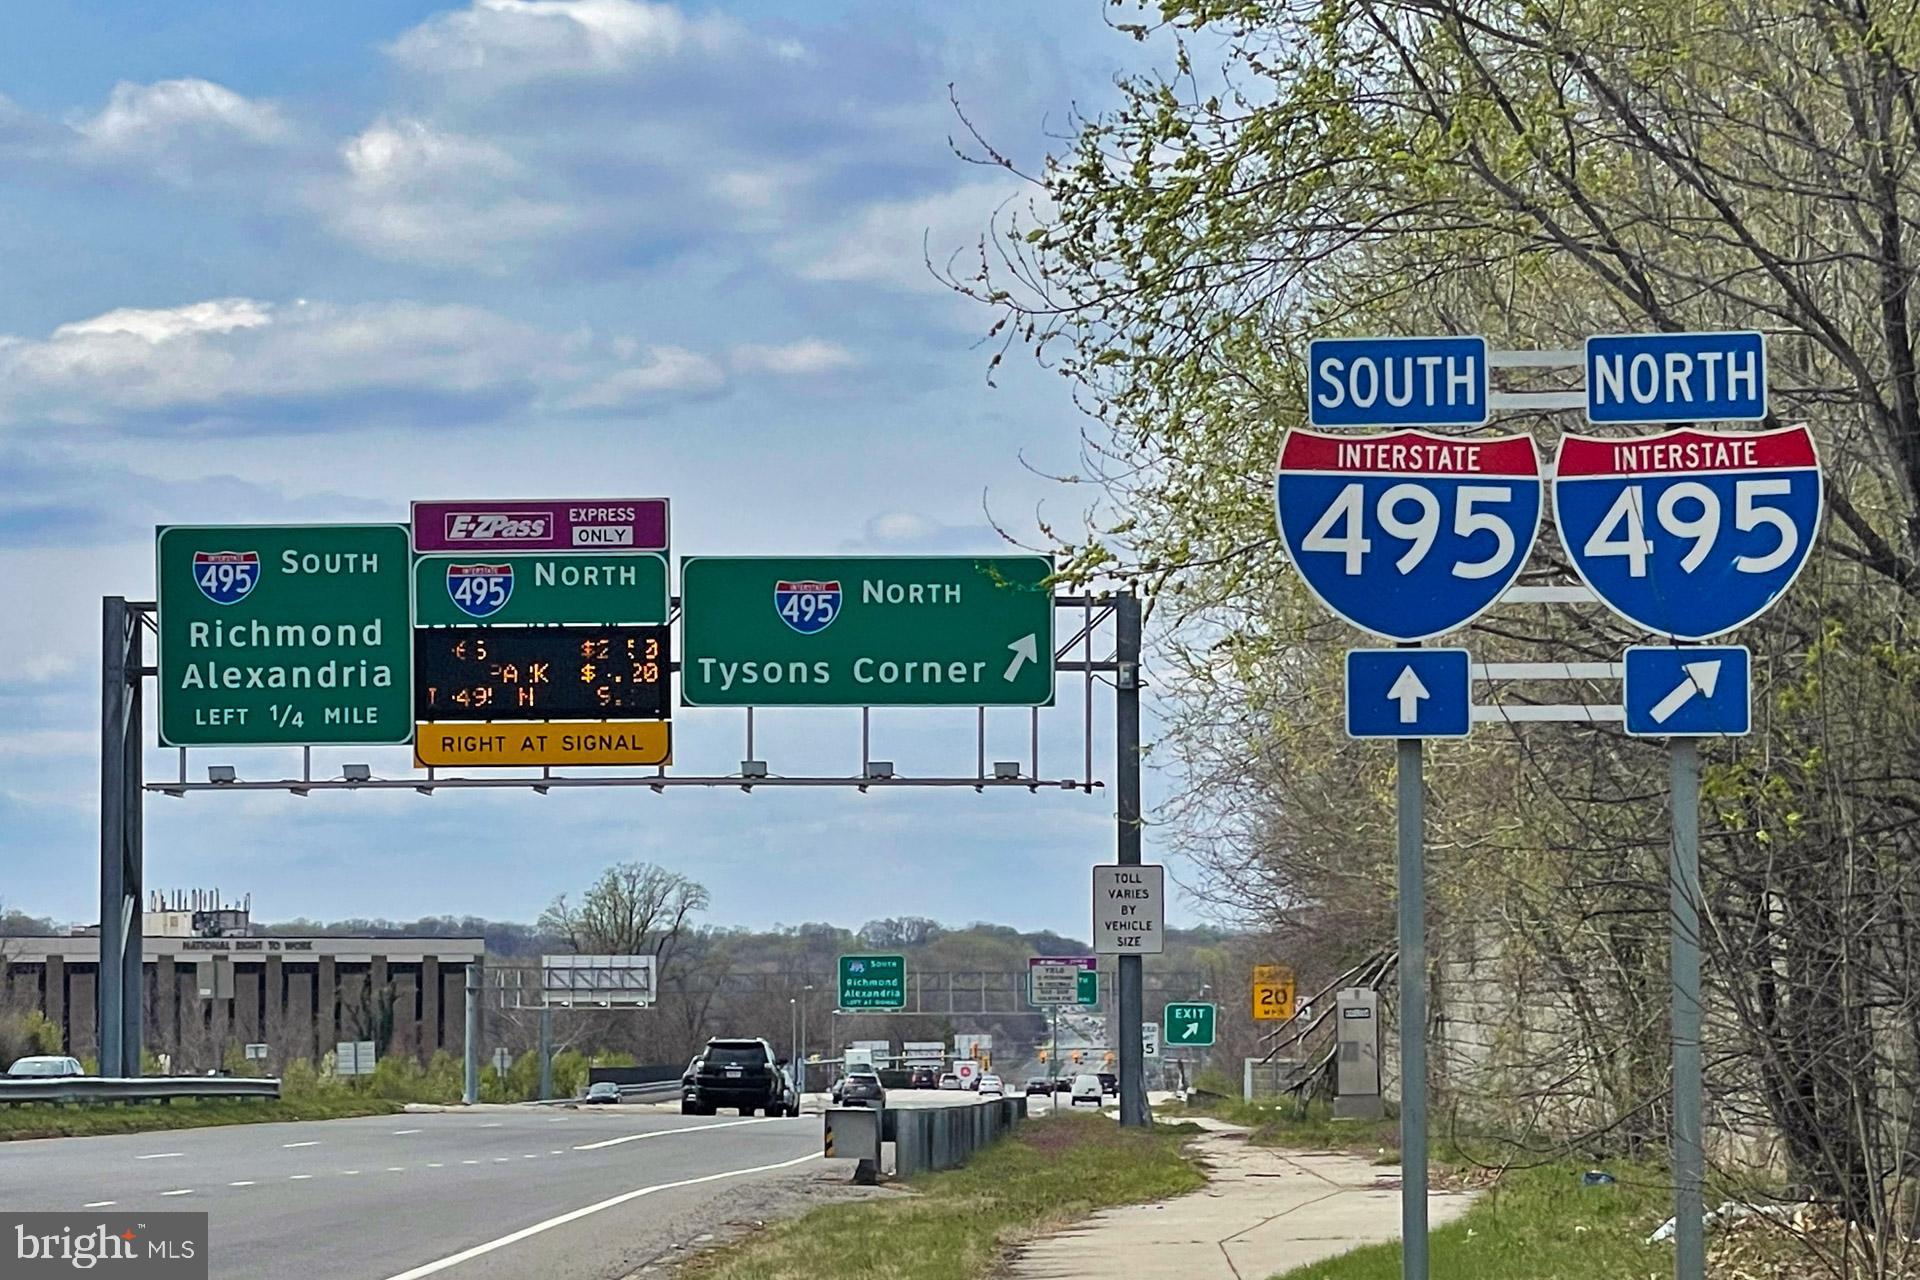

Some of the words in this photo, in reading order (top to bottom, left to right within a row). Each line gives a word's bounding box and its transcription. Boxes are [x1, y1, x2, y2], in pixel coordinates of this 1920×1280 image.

[1317, 356, 1475, 408] SOUTH
[1596, 351, 1757, 405] NORTH
[1338, 444, 1481, 472] INTERSTATE
[1613, 440, 1758, 471] INTERSTATE
[449, 515, 546, 538] E-ZPass
[569, 508, 635, 522] EXPRESS
[578, 529, 626, 543] ONLY
[1301, 483, 1516, 579] 495
[1584, 478, 1798, 578] 495
[281, 549, 378, 574] SOUTH
[200, 565, 252, 593] 495
[535, 562, 636, 587] NORTH
[454, 577, 505, 606] 495
[862, 579, 961, 604] NORTH
[782, 594, 833, 623] 495
[190, 618, 382, 647] Richmond
[181, 659, 391, 689] Alexandria
[698, 657, 830, 691] Tysons
[853, 657, 986, 684] Corner
[195, 709, 249, 725] LEFT
[324, 707, 378, 724] MILE
[442, 736, 507, 752] RIGHT
[521, 735, 548, 752] AT
[562, 734, 644, 751] SIGNAL
[1115, 873, 1142, 884] TOLL
[1108, 889, 1150, 899] VARIES
[1121, 905, 1136, 915] BY
[1105, 920, 1152, 931] VEHICLE
[1117, 936, 1141, 947] SIZE
[844, 989, 901, 998] Alexandria
[846, 978, 898, 987] Richmond
[1260, 989, 1288, 1006] 20
[1175, 1008, 1206, 1019] EXIT
